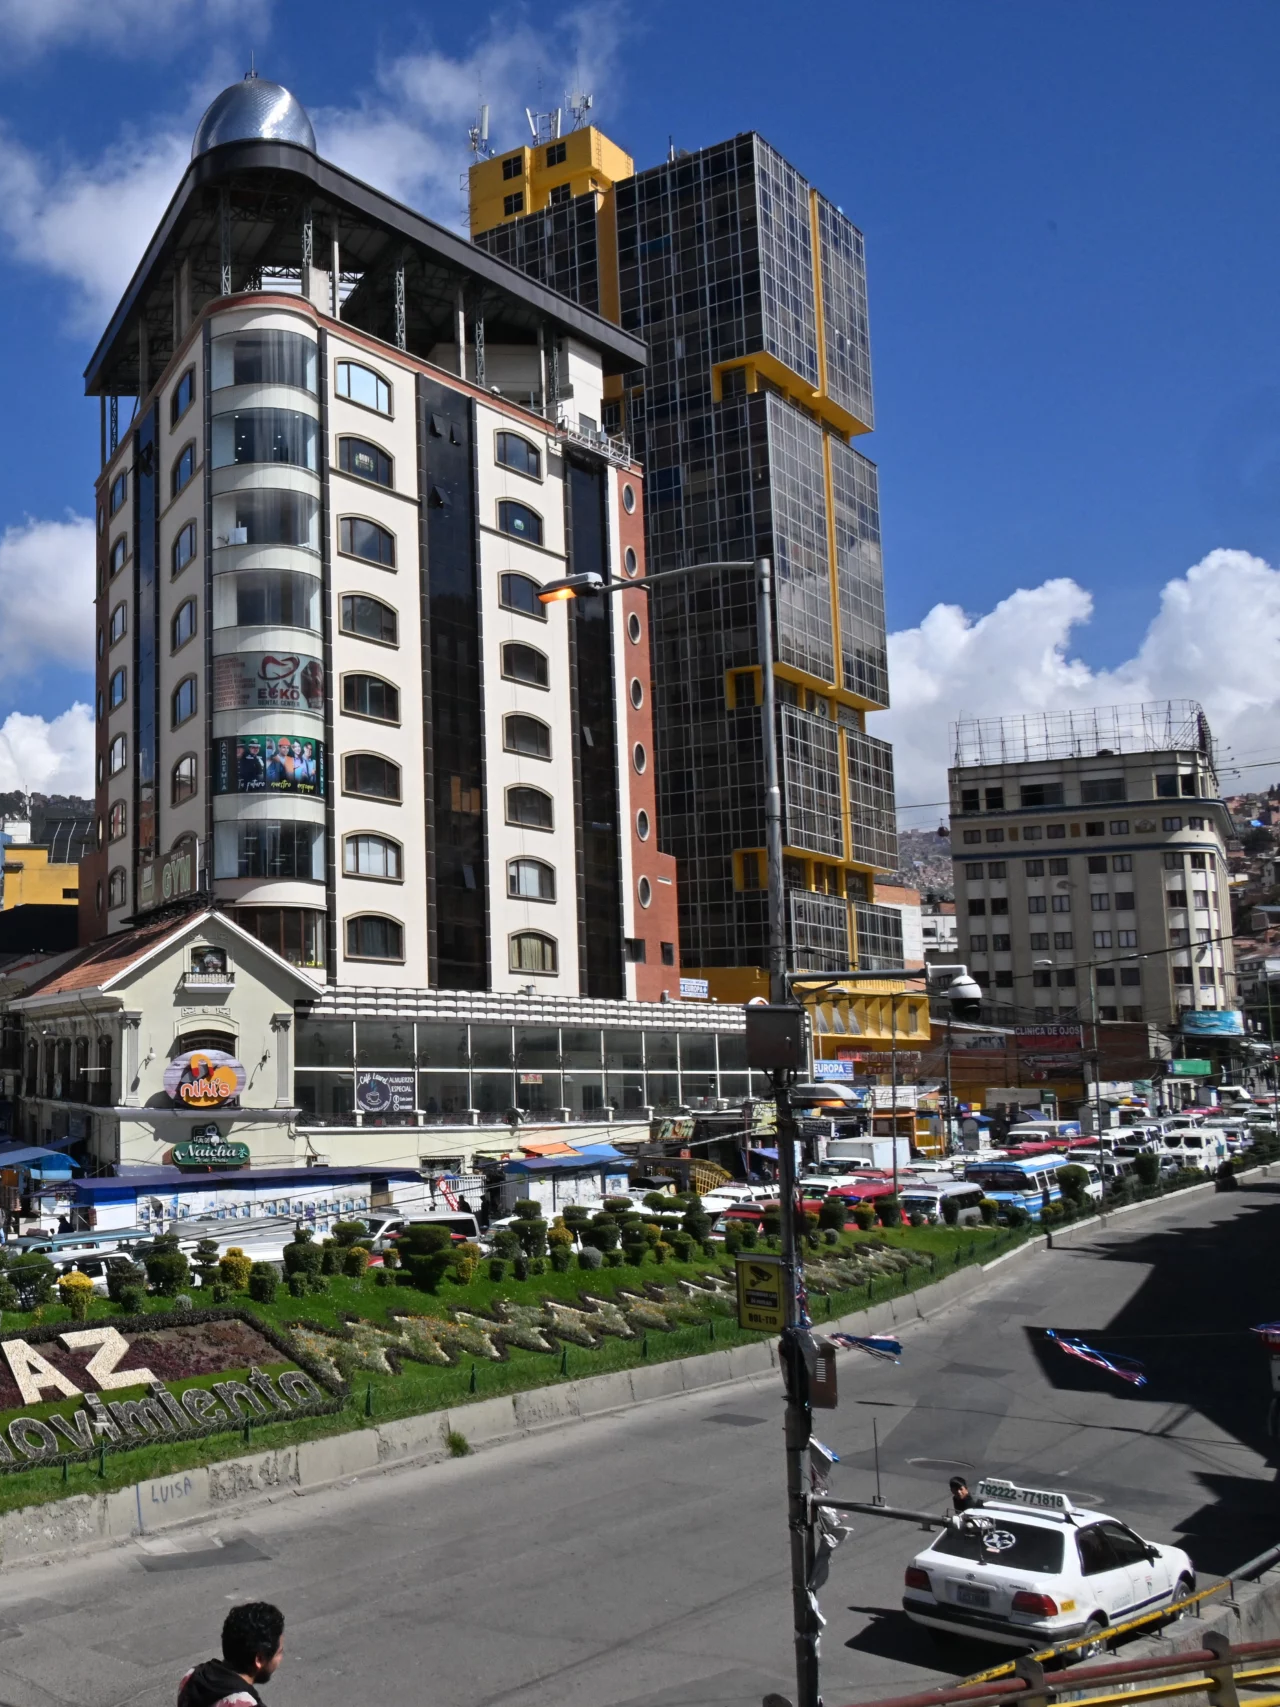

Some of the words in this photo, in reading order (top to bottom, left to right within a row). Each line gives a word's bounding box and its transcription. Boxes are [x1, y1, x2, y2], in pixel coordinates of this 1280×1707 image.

[162, 854, 191, 899] GYM
[1015, 1026, 1046, 1036] CLINICA
[1047, 1026, 1058, 1035] DE
[1059, 1025, 1080, 1035] OJOS
[814, 1063, 845, 1073] EUROPA
[180, 1078, 230, 1098] niki's
[151, 1476, 192, 1503] LUISA
